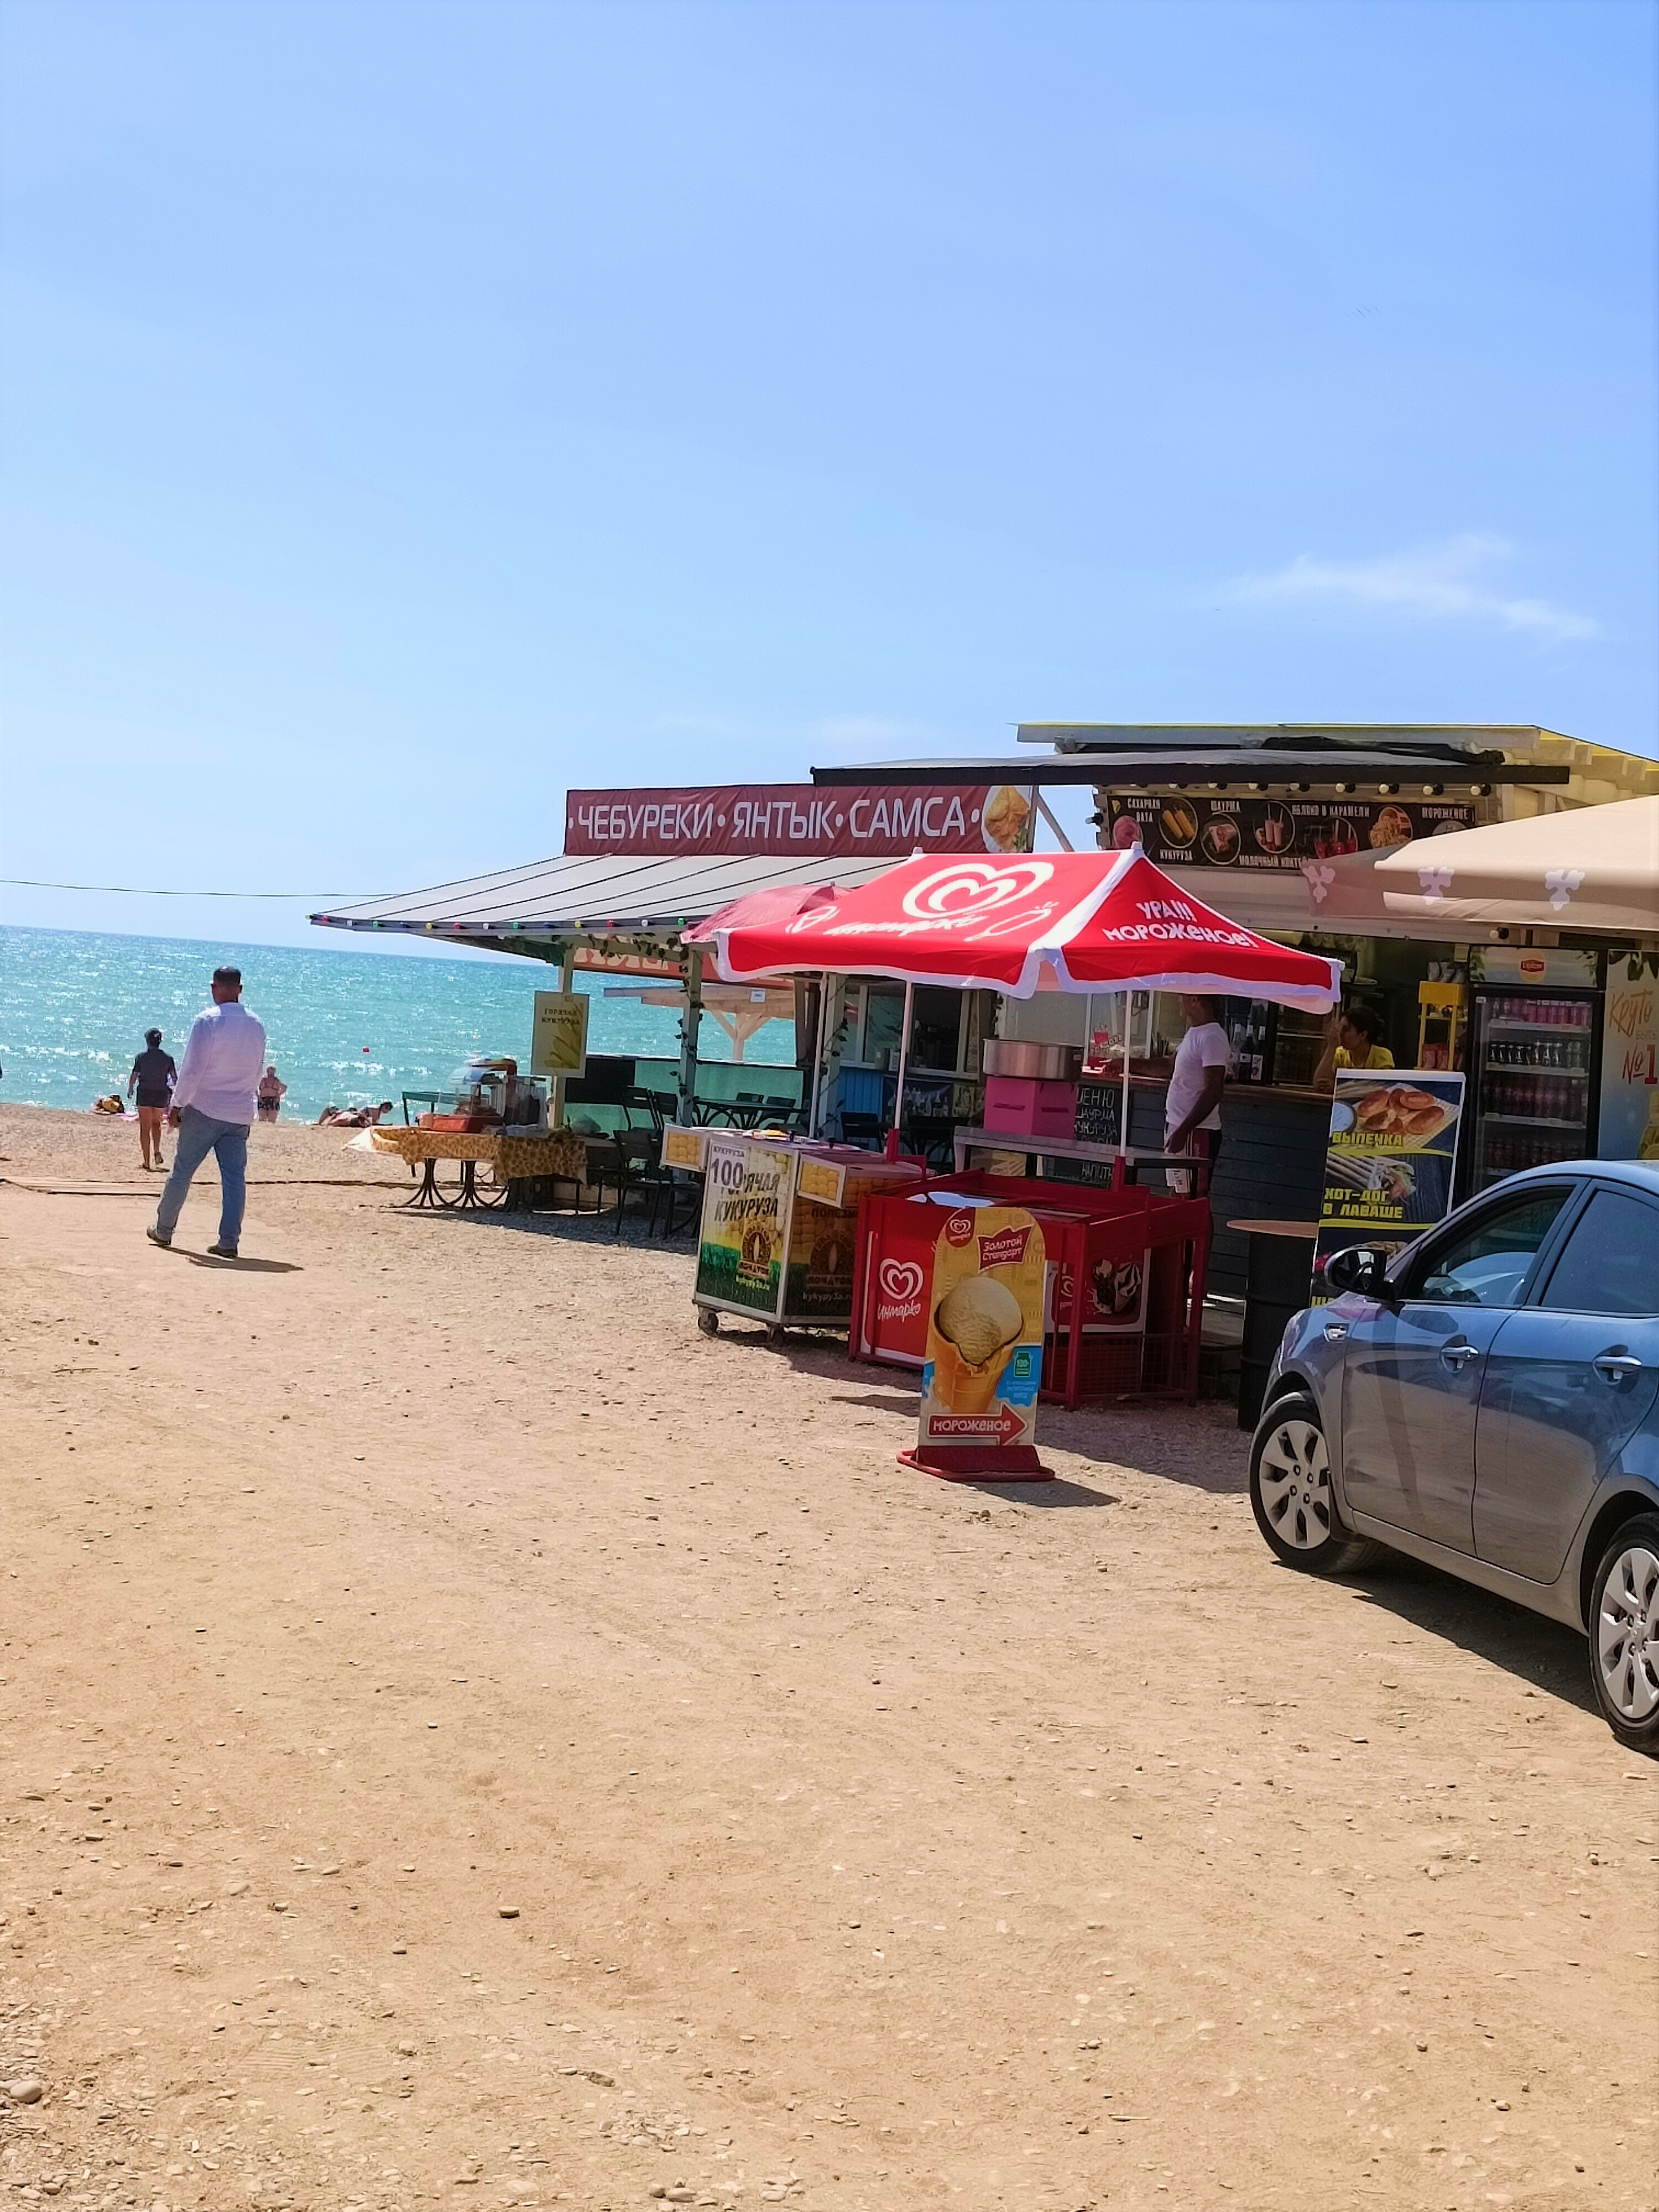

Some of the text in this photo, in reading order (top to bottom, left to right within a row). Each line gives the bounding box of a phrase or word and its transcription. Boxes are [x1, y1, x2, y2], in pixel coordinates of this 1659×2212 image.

[578, 796, 966, 839] ЧЕБУРЕКИ ЯНТЫК САМСА
[1332, 1132, 1403, 1146] ВЫПЕЧКА
[711, 1158, 743, 1189] 100
[1324, 1187, 1390, 1202] ХОТ-ДОГ
[714, 1197, 779, 1222] КУКУРУЗА
[1323, 1203, 1404, 1219] В ЛАВАШЕ
